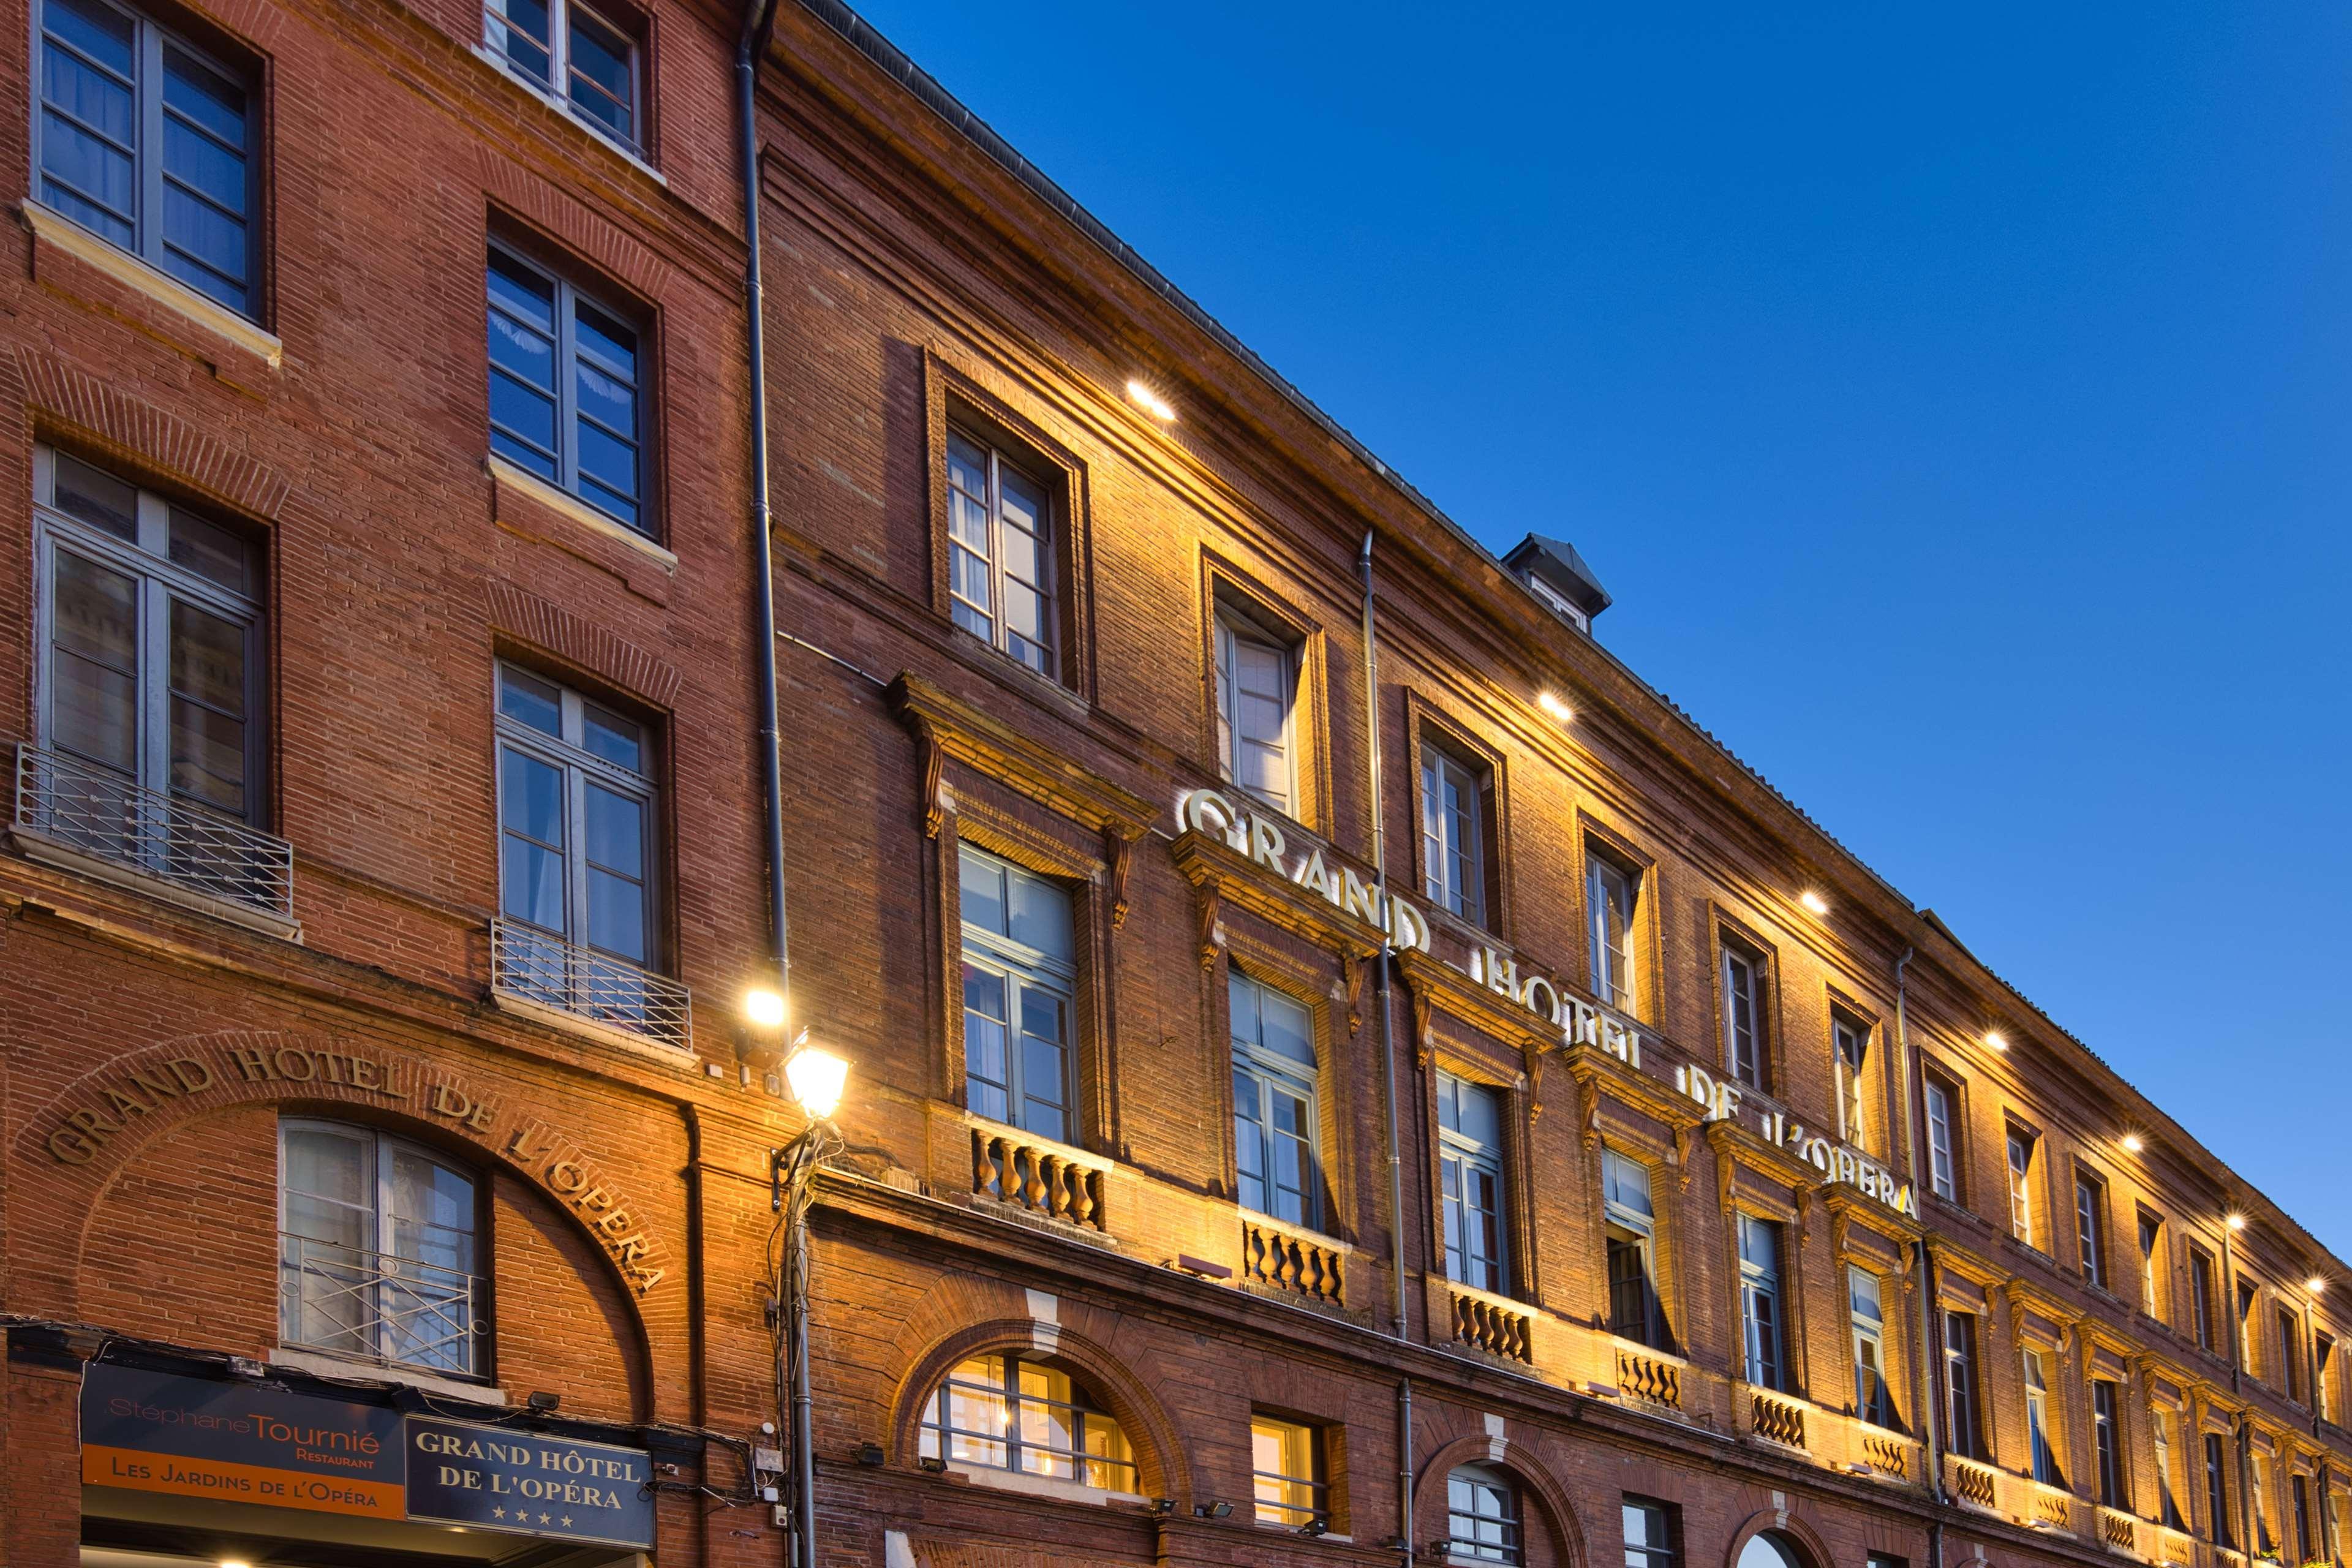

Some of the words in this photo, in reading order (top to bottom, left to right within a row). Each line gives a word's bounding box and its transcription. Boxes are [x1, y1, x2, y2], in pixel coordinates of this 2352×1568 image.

[1183, 789, 1431, 954] GRAND
[48, 1057, 214, 1164] GRAND
[232, 1047, 409, 1099] HOTEL
[432, 1084, 496, 1133] DE
[416, 1432, 530, 1466] GRAND
[539, 1450, 641, 1483] HÔTEL
[439, 1466, 481, 1490] DE
[491, 1474, 622, 1509] L'OPÉRA
